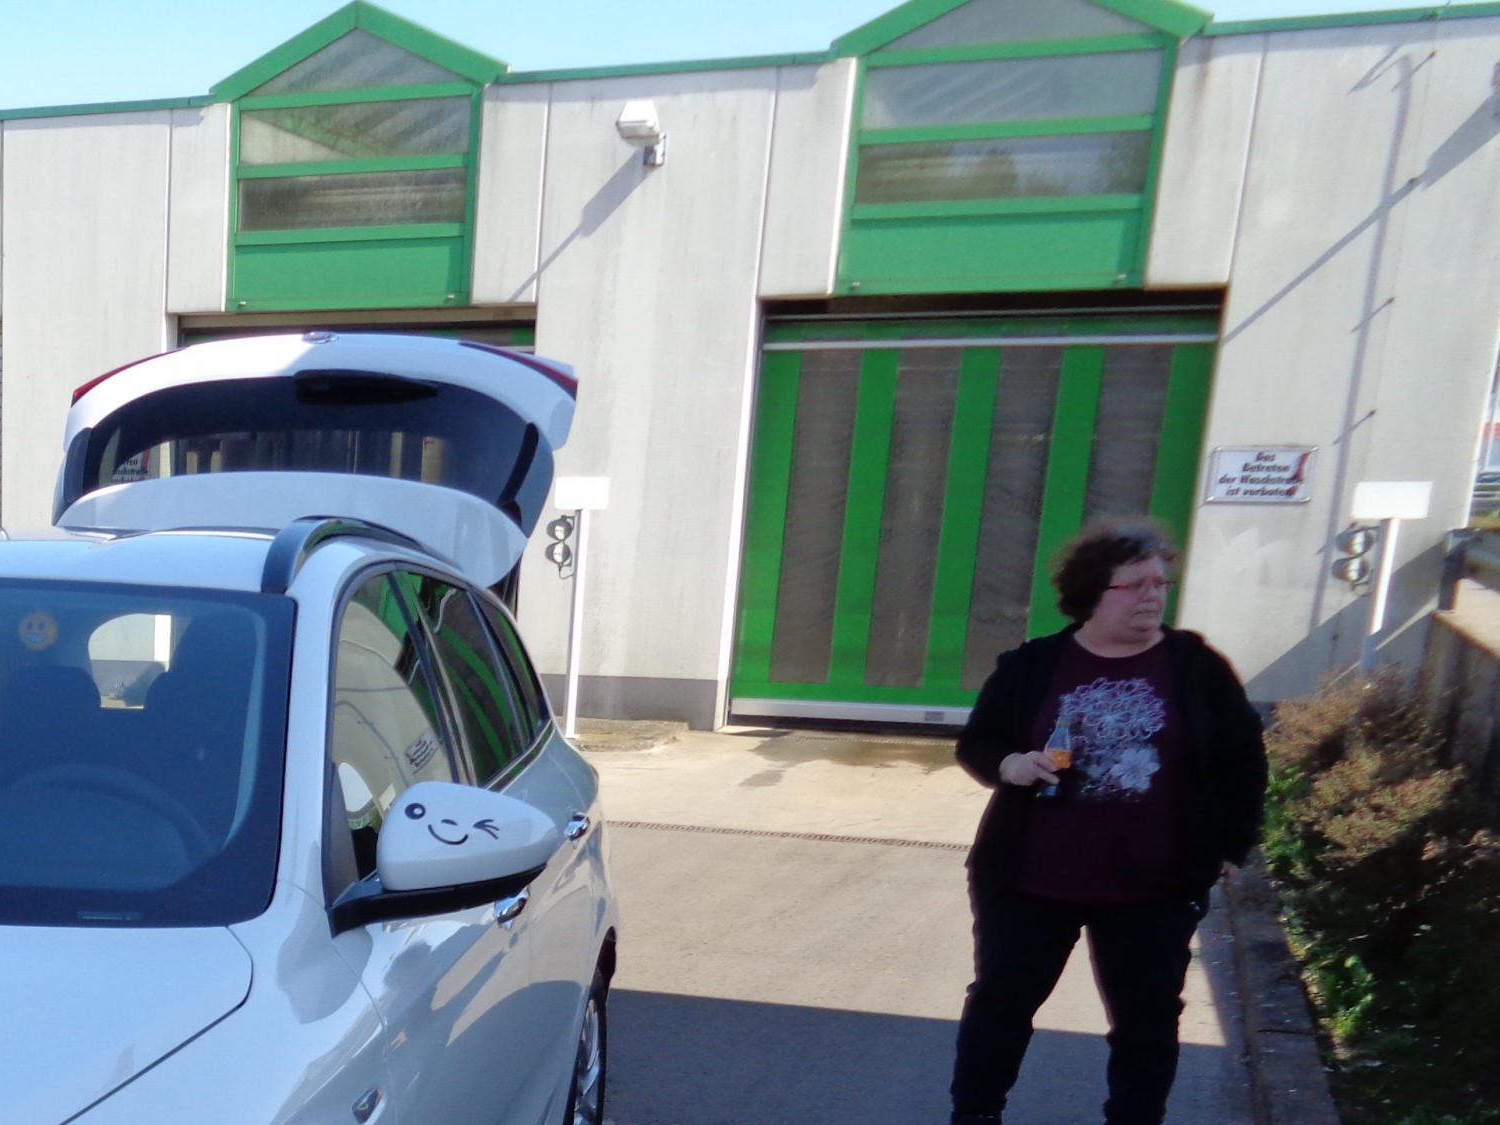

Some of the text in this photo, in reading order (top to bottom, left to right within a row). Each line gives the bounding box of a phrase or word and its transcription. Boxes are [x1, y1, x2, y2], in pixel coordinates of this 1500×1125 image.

[1242, 462, 1290, 472] Betreten
[1219, 473, 1237, 484] der
[1226, 486, 1241, 496] ist
